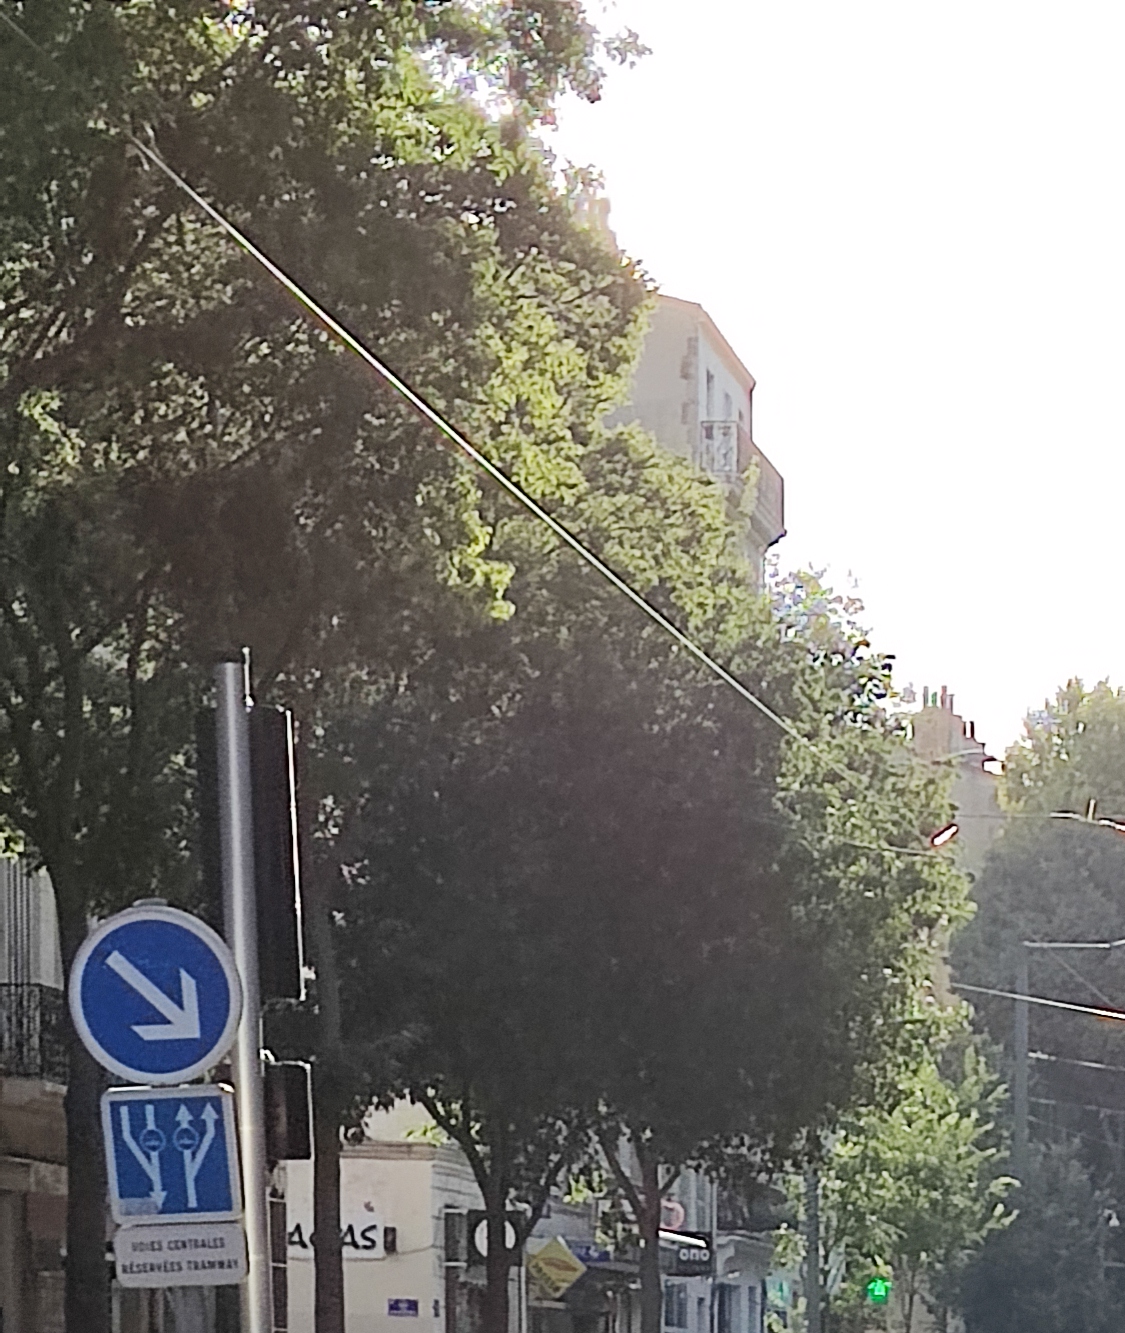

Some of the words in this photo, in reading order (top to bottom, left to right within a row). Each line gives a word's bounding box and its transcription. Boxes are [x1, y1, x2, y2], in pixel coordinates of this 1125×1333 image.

[167, 1236, 226, 1251] CENTRALES
[287, 1223, 378, 1250] AAS
[121, 1260, 183, 1274] RÉSERVÉES
[186, 1258, 239, 1271] TRAMWAY
